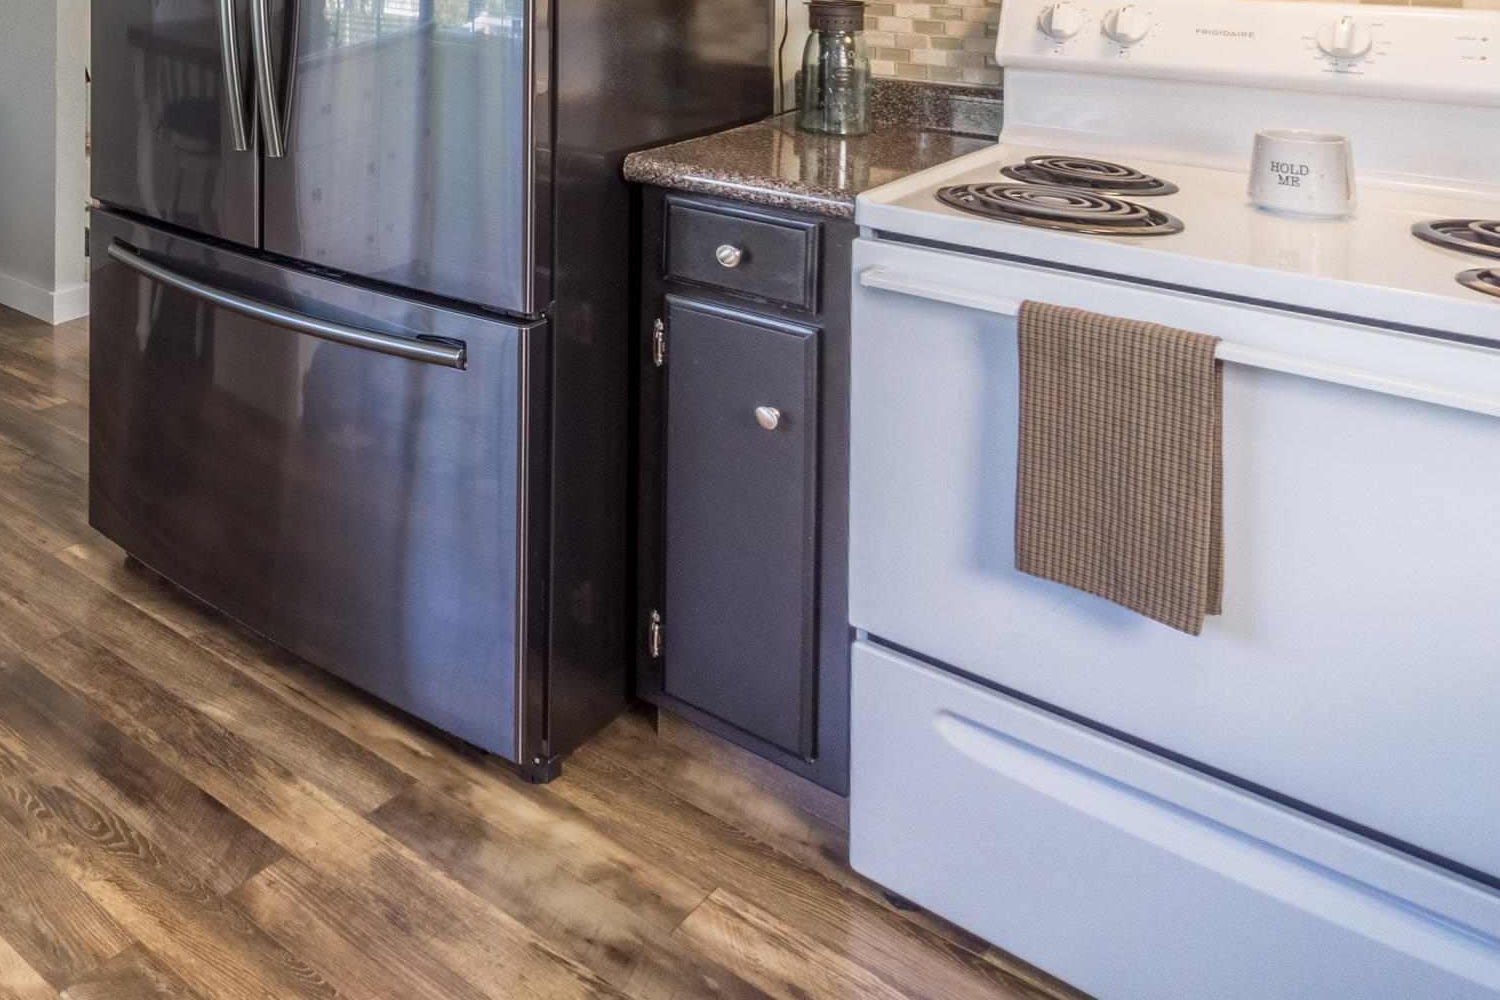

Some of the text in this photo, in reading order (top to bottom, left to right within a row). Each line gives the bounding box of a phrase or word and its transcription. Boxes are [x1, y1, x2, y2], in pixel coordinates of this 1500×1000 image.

[1195, 28, 1255, 39] FRIGIDAIRE
[1270, 160, 1309, 176] HOLD
[1278, 174, 1300, 188] ME
